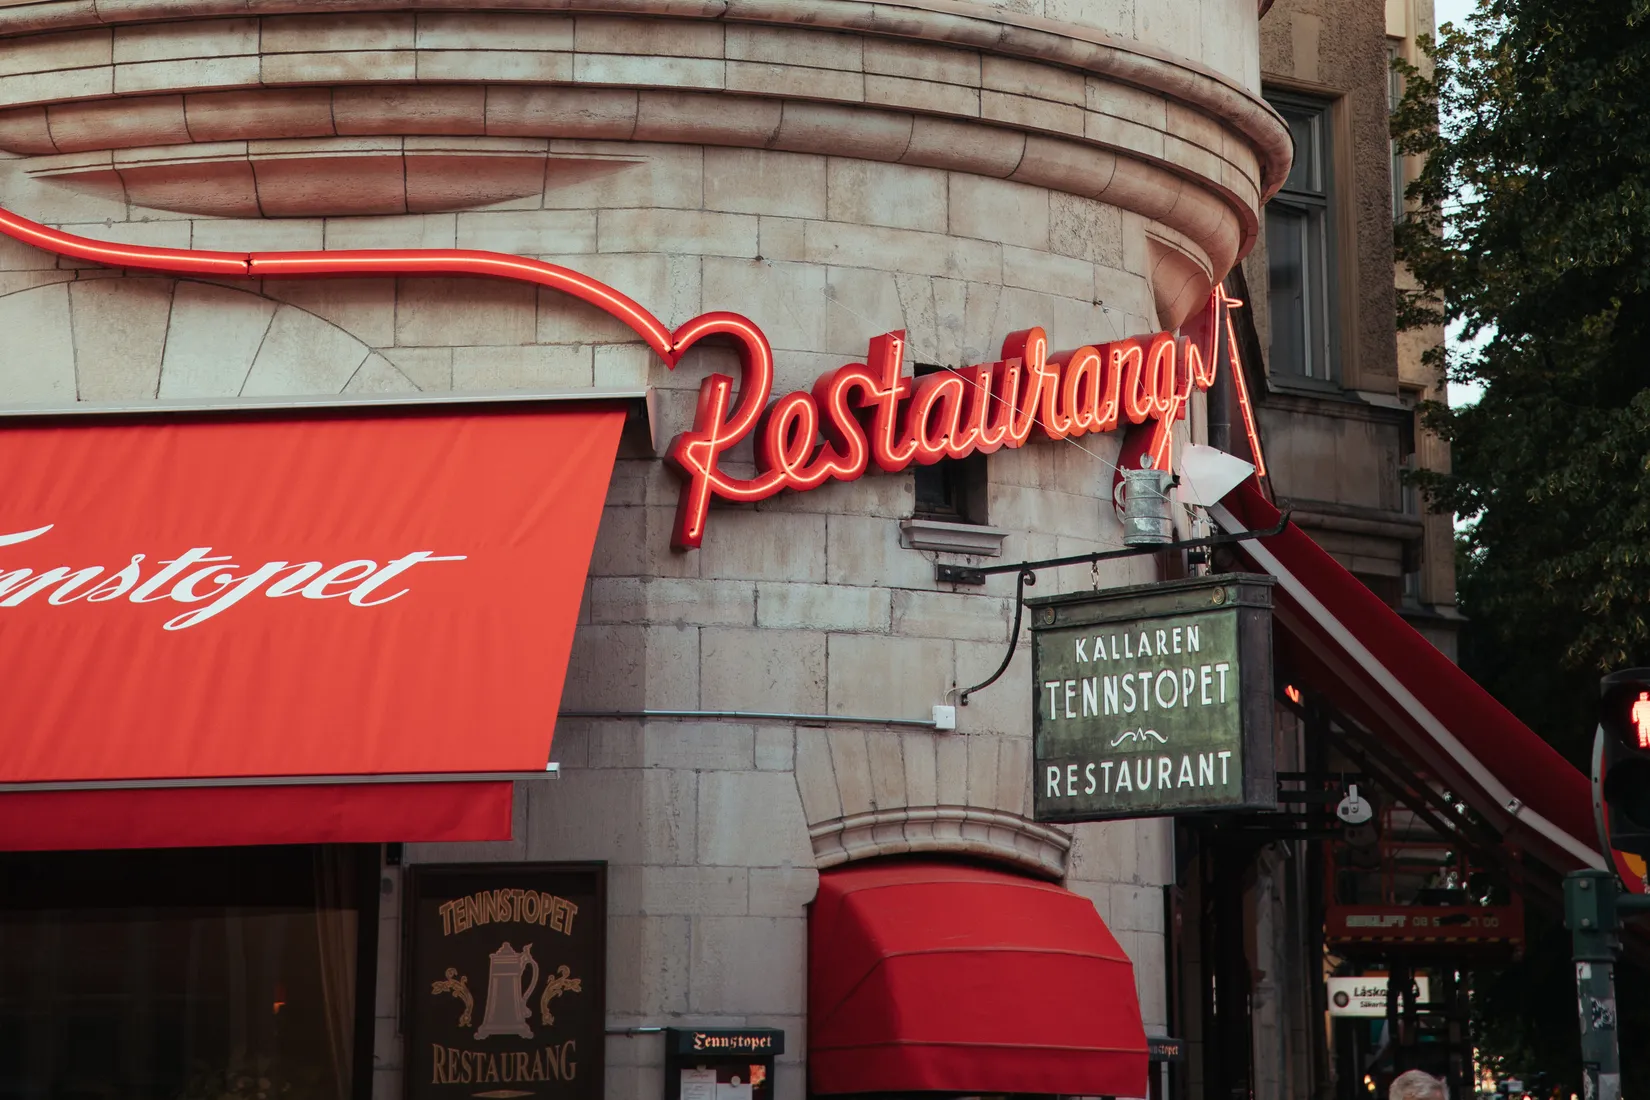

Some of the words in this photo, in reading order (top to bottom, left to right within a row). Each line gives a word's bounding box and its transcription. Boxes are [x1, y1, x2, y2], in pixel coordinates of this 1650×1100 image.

[664, 310, 1190, 550] Restaurang
[1075, 625, 1200, 663] KÄLLAREN
[1045, 663, 1230, 720] TENNSTOPET
[1046, 751, 1231, 798] RESTAURANT
[438, 888, 578, 936] TENNSTOPET
[431, 1040, 578, 1084] RESTAURANG
[692, 1031, 773, 1052] Tennstopet
